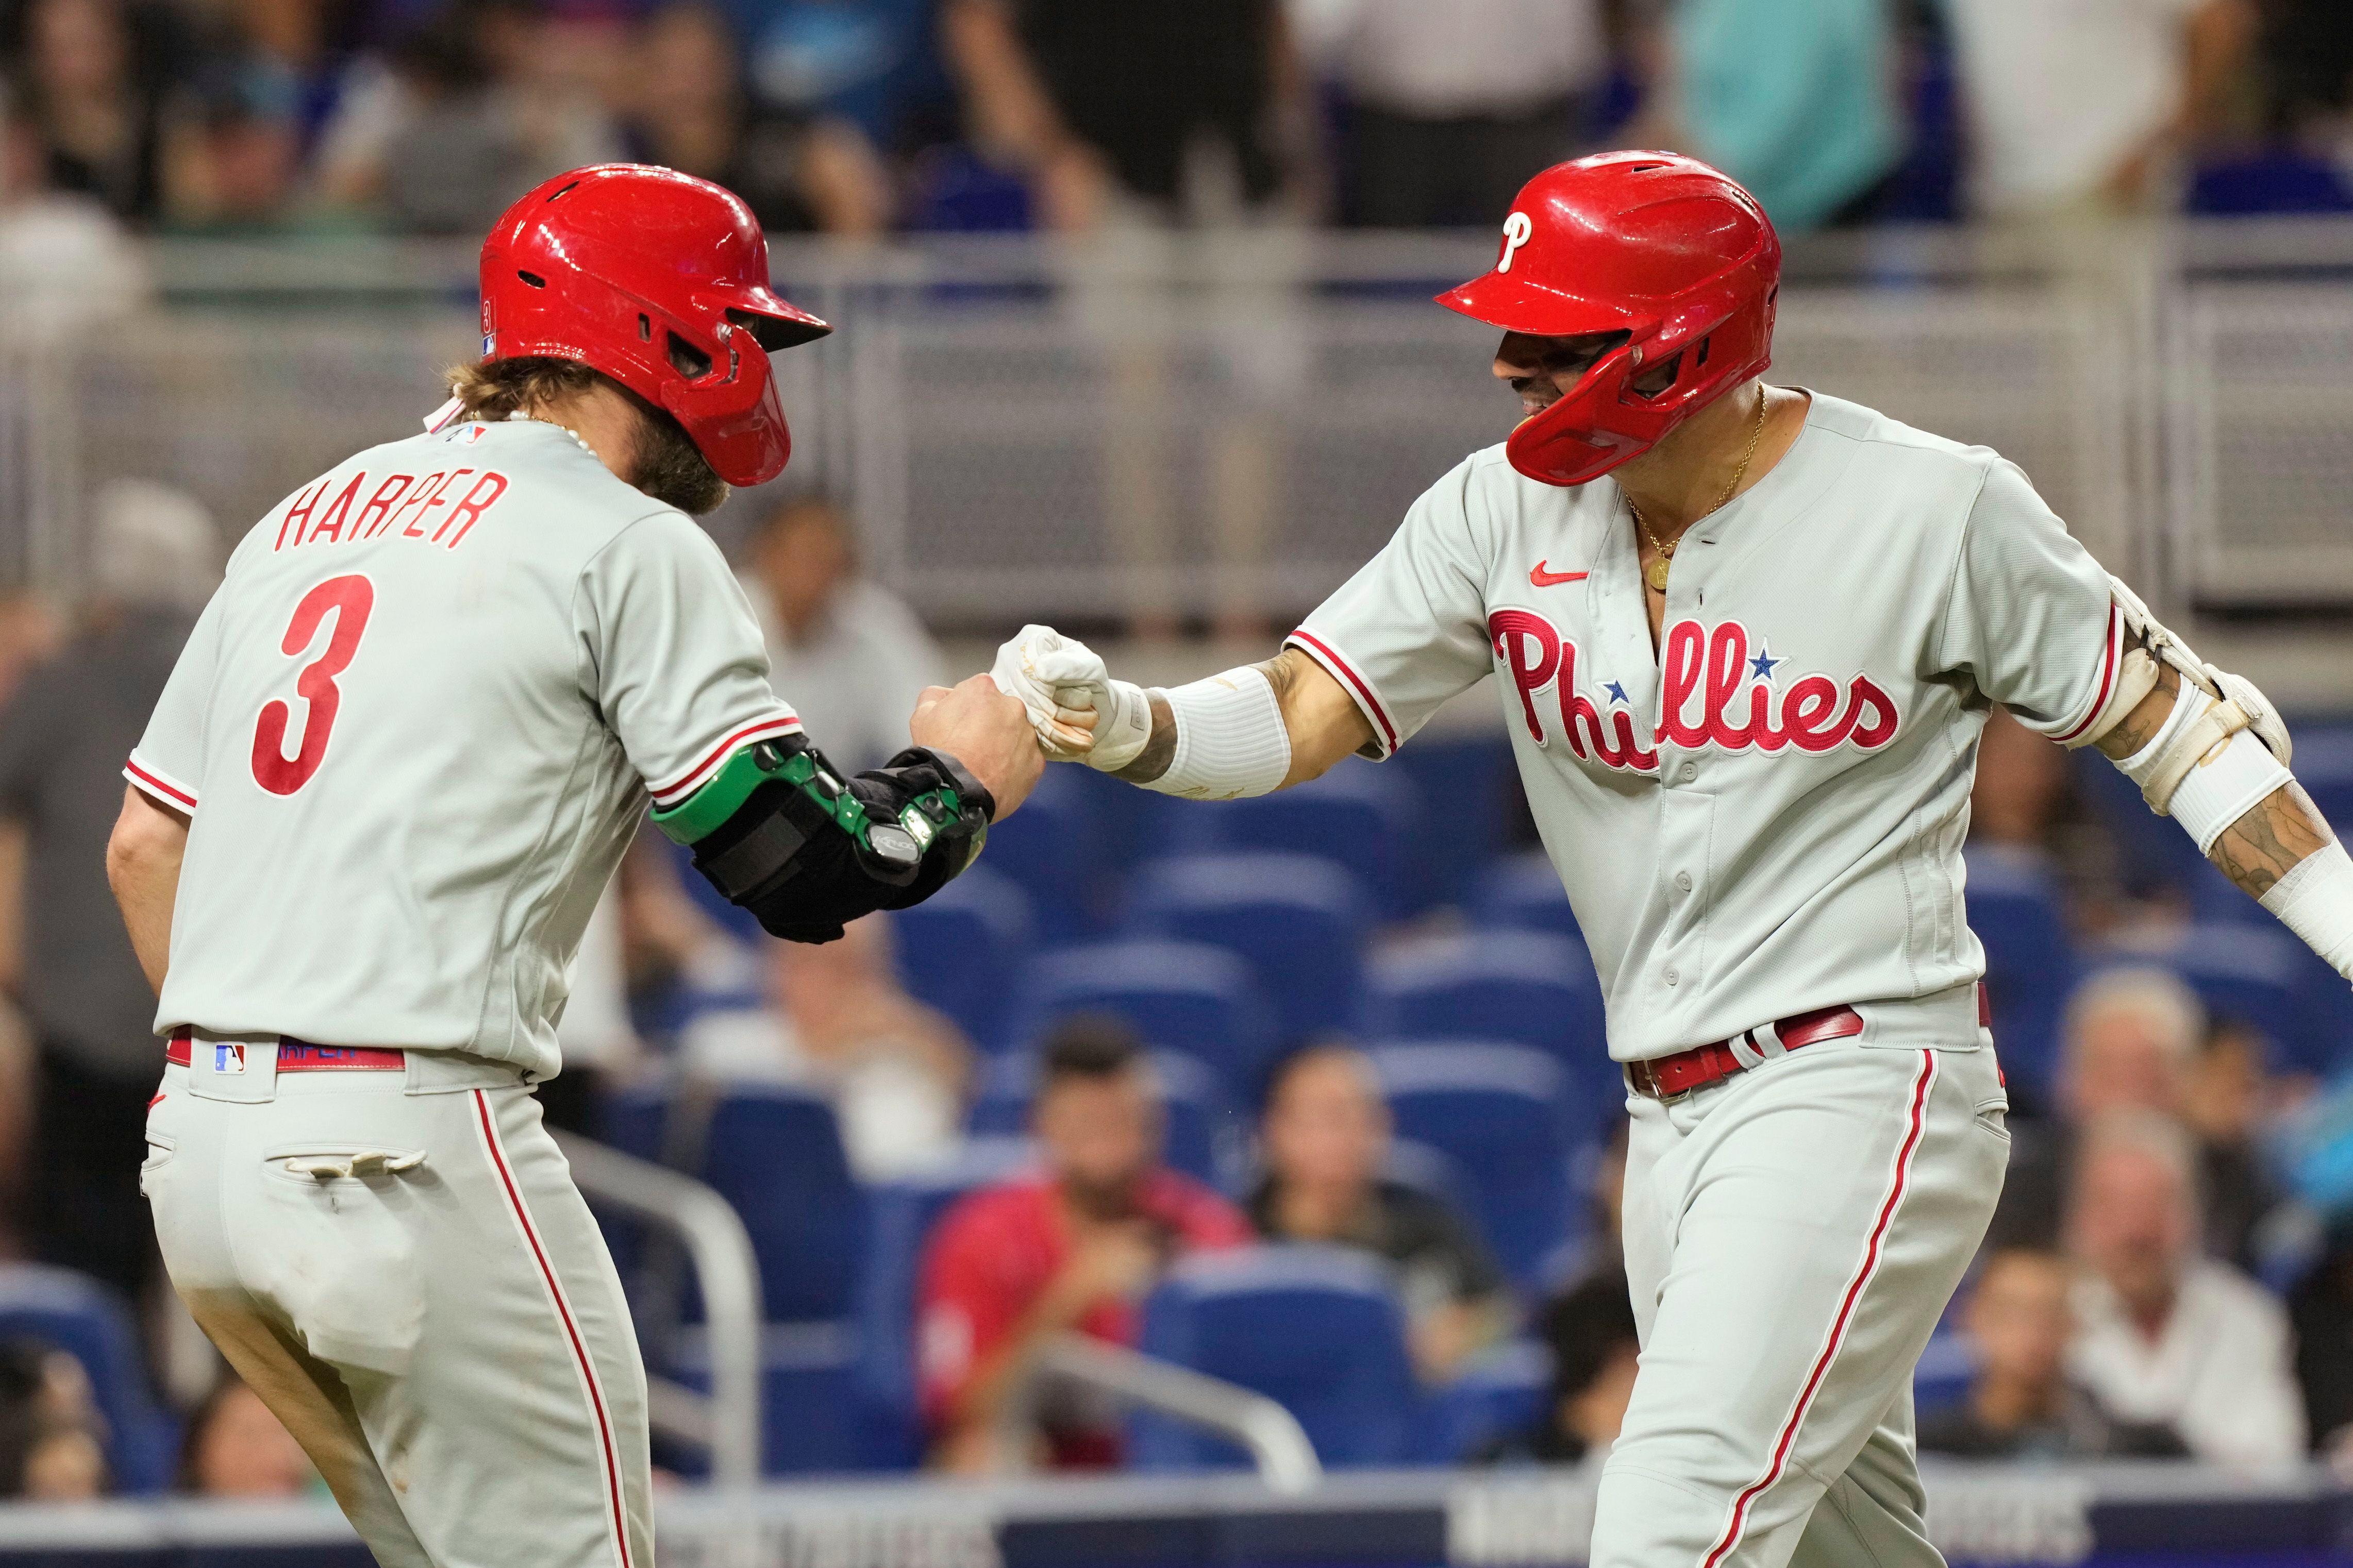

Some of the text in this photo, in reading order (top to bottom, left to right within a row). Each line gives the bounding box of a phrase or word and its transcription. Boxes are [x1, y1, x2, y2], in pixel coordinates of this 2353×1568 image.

[1498, 212, 1532, 274] P
[483, 300, 491, 333] 3
[274, 468, 510, 553] HARPER
[250, 572, 376, 797] 3
[1487, 607, 1901, 772] Phillies
